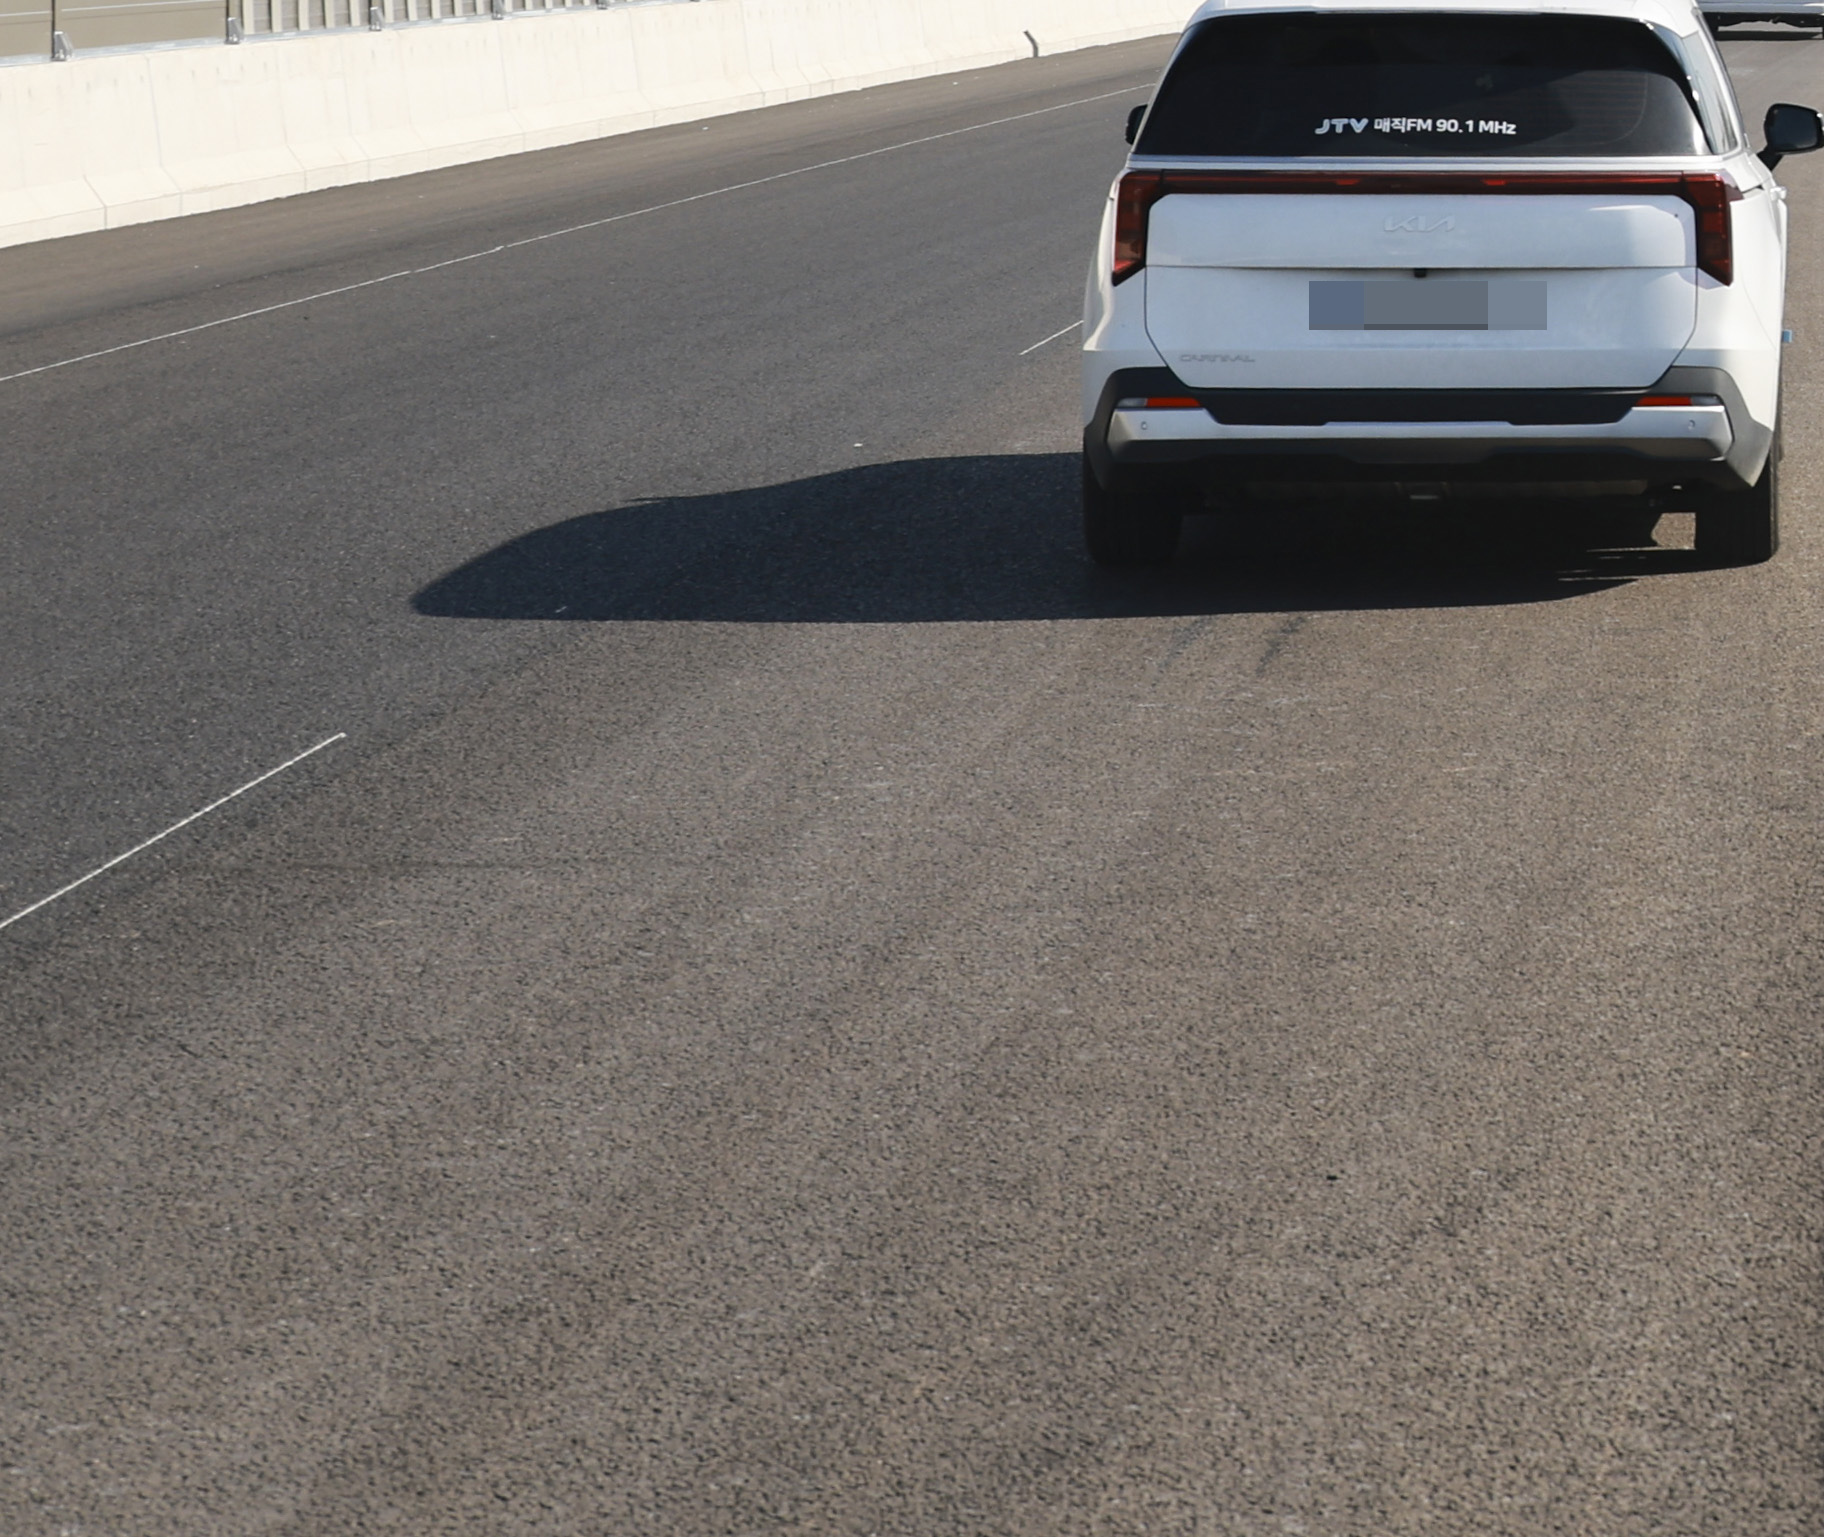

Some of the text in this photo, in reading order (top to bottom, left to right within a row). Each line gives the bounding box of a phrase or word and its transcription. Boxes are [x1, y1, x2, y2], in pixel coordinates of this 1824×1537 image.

[1315, 117, 1517, 135] JTV 매직FM 90.1 MHz
[1383, 215, 1456, 233] KIA
